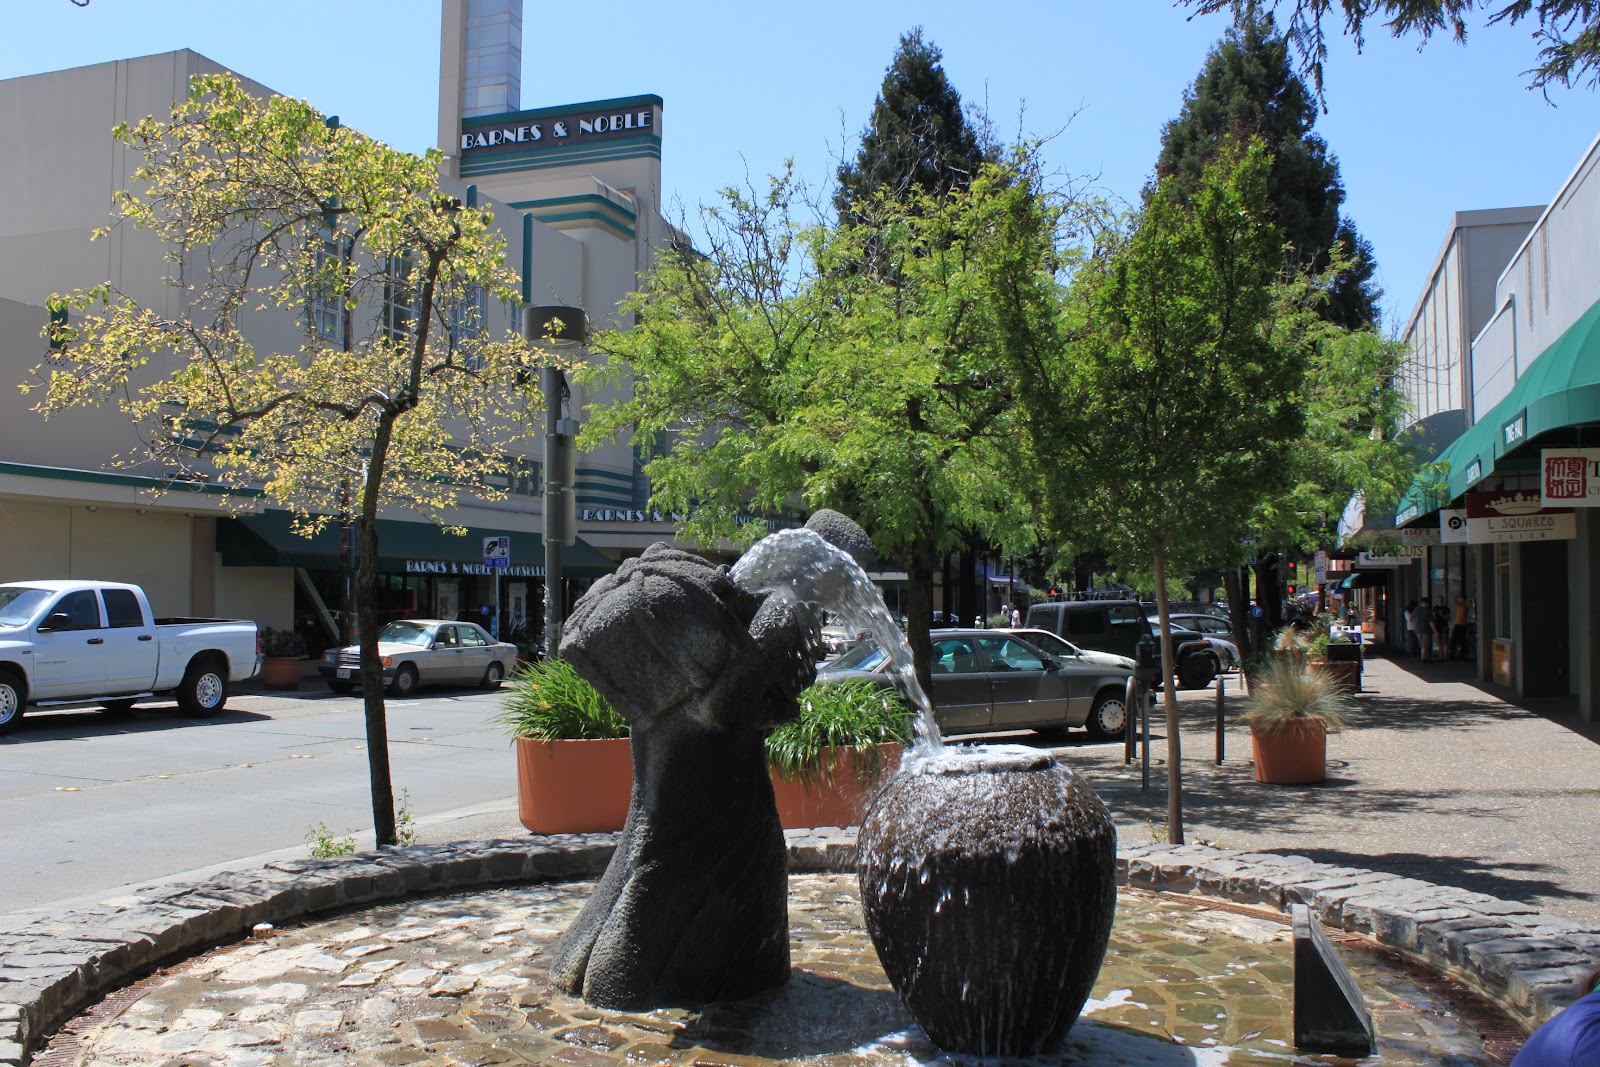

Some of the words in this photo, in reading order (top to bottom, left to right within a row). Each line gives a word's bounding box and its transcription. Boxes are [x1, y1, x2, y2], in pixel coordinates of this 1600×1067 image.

[461, 124, 542, 150] BARNES
[553, 121, 568, 138] &
[579, 111, 651, 135] NOBLE
[582, 509, 645, 522] BARNES
[652, 511, 663, 522] &
[1487, 519, 1494, 529] L
[1501, 516, 1555, 529] SQUARED
[1498, 532, 1545, 540] SALON
[1371, 545, 1423, 558] SUPCUTS
[406, 560, 447, 573] BARNES
[451, 561, 459, 573] &
